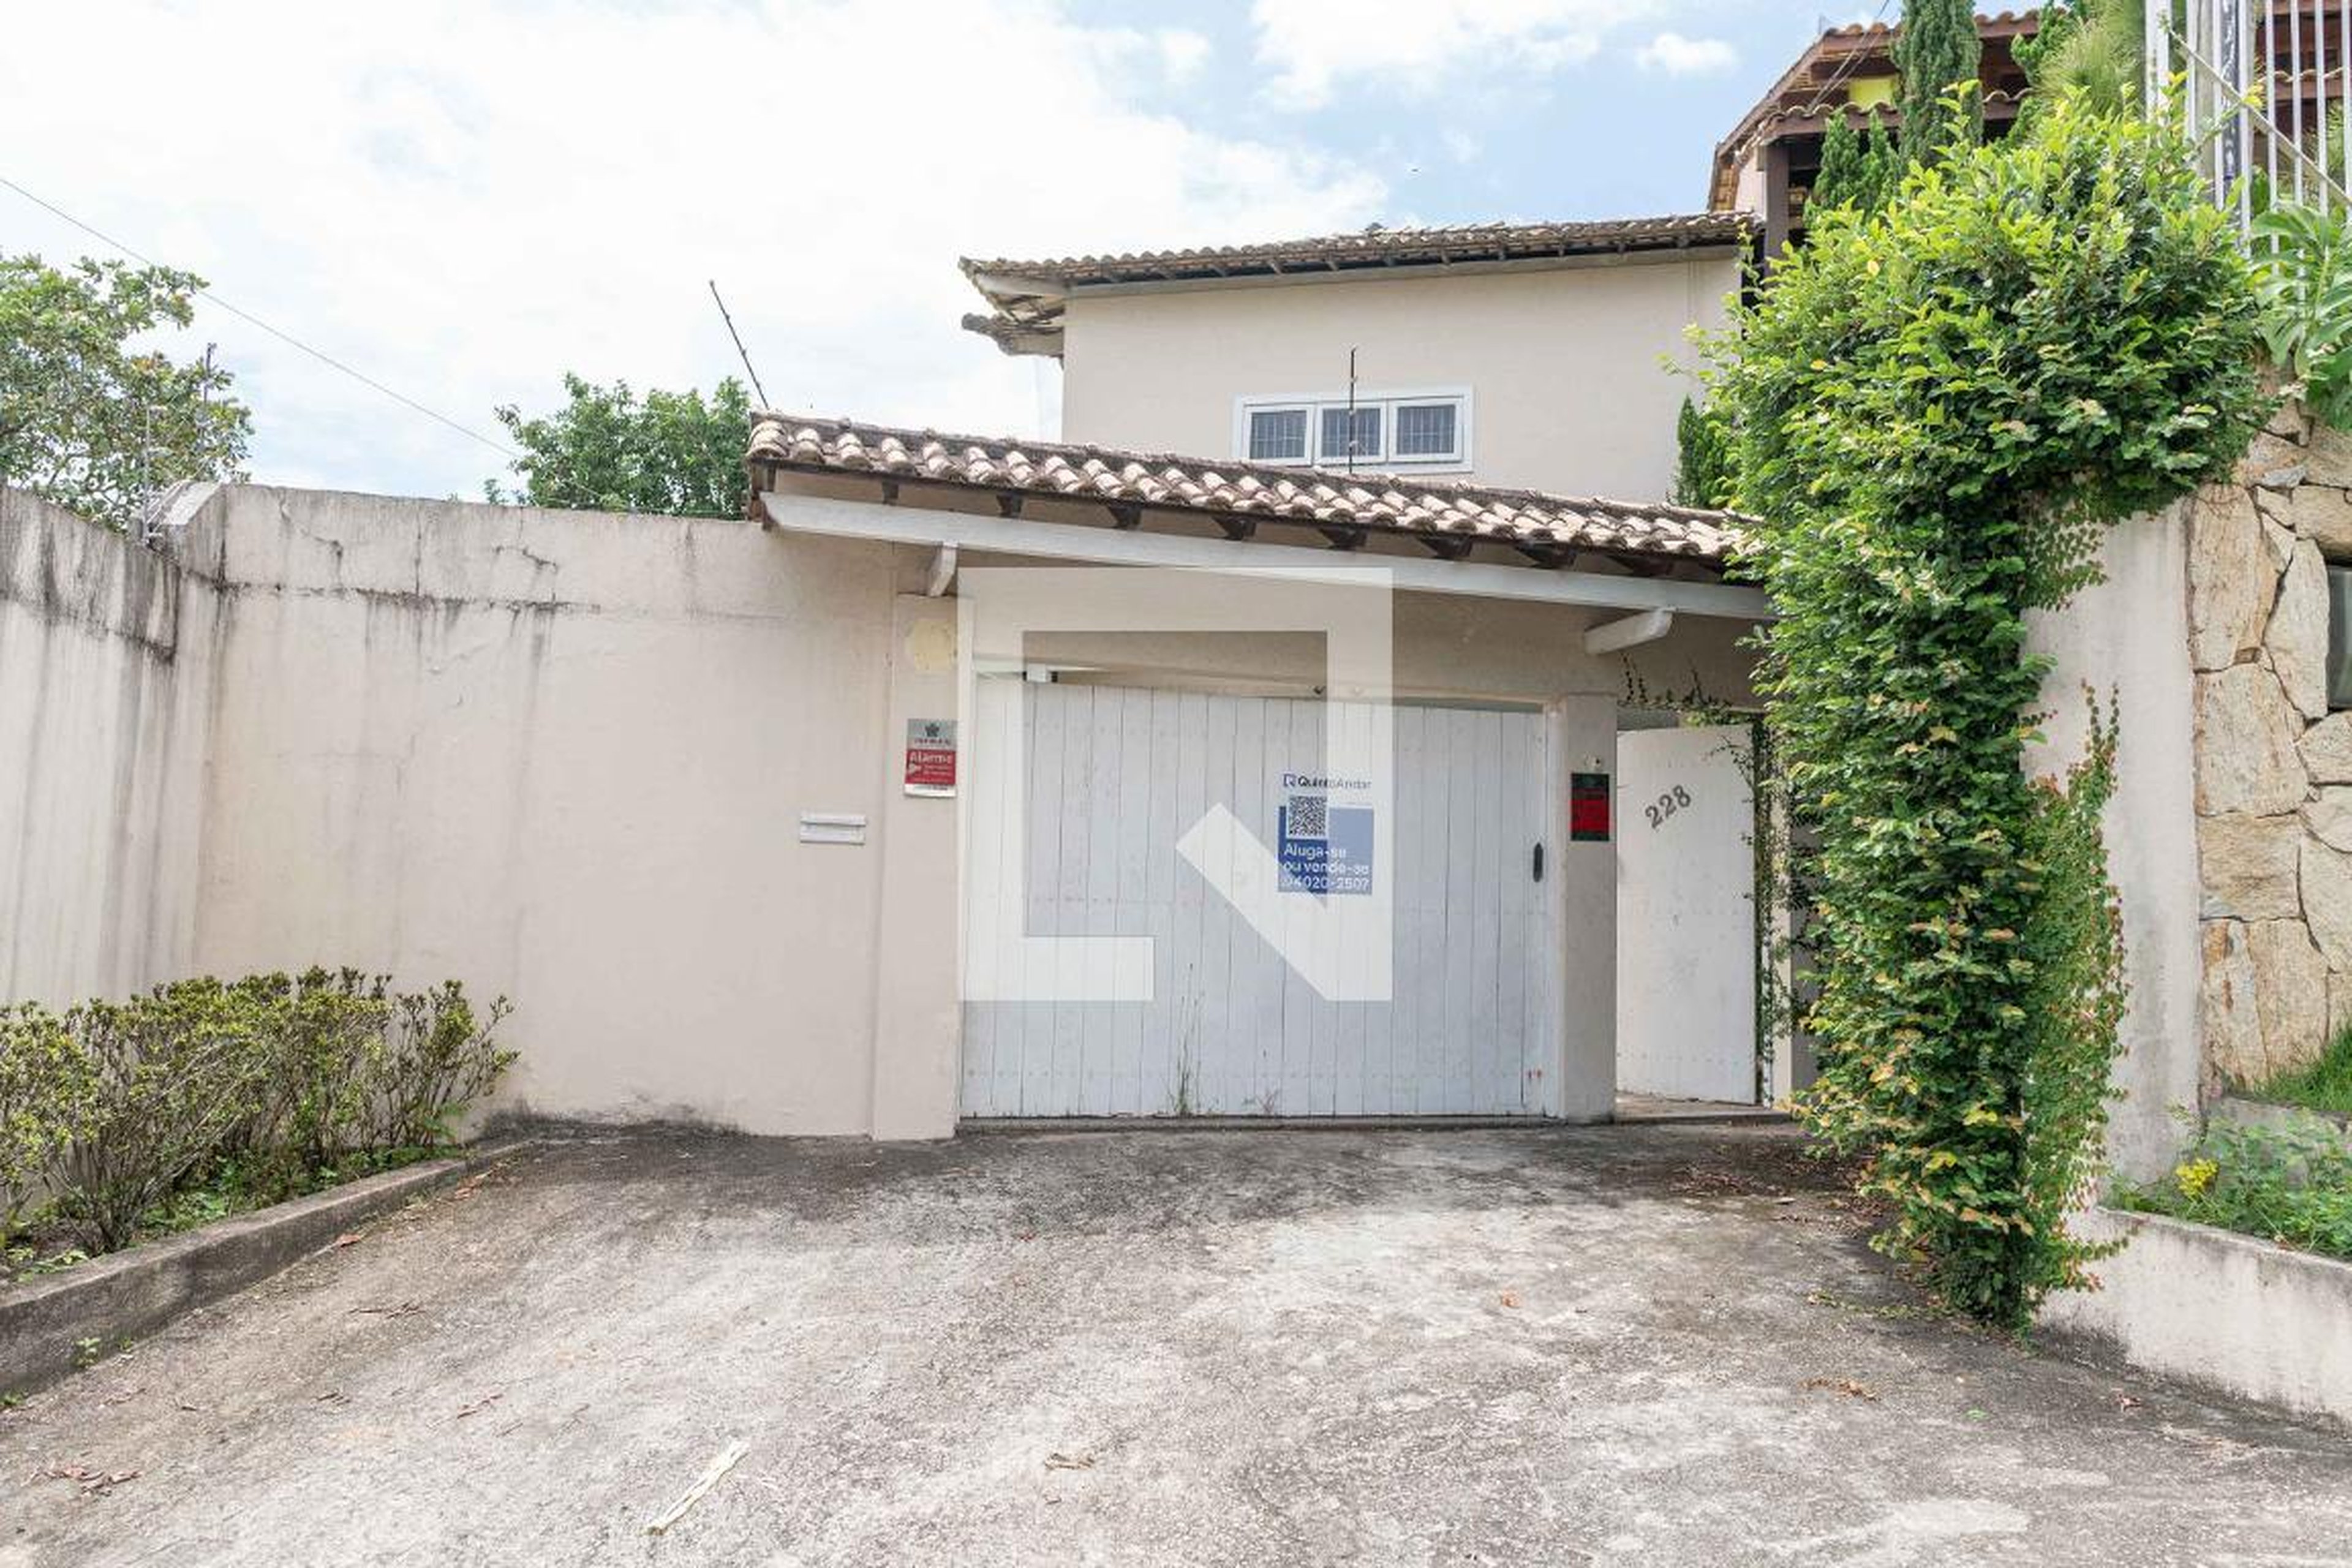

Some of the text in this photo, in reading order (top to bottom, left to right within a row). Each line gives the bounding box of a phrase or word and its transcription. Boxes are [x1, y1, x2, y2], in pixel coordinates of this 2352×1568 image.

[1645, 785, 1691, 829] 228
[1284, 843, 1347, 859] Aluga-se
[1283, 859, 1370, 875] ou vende-se
